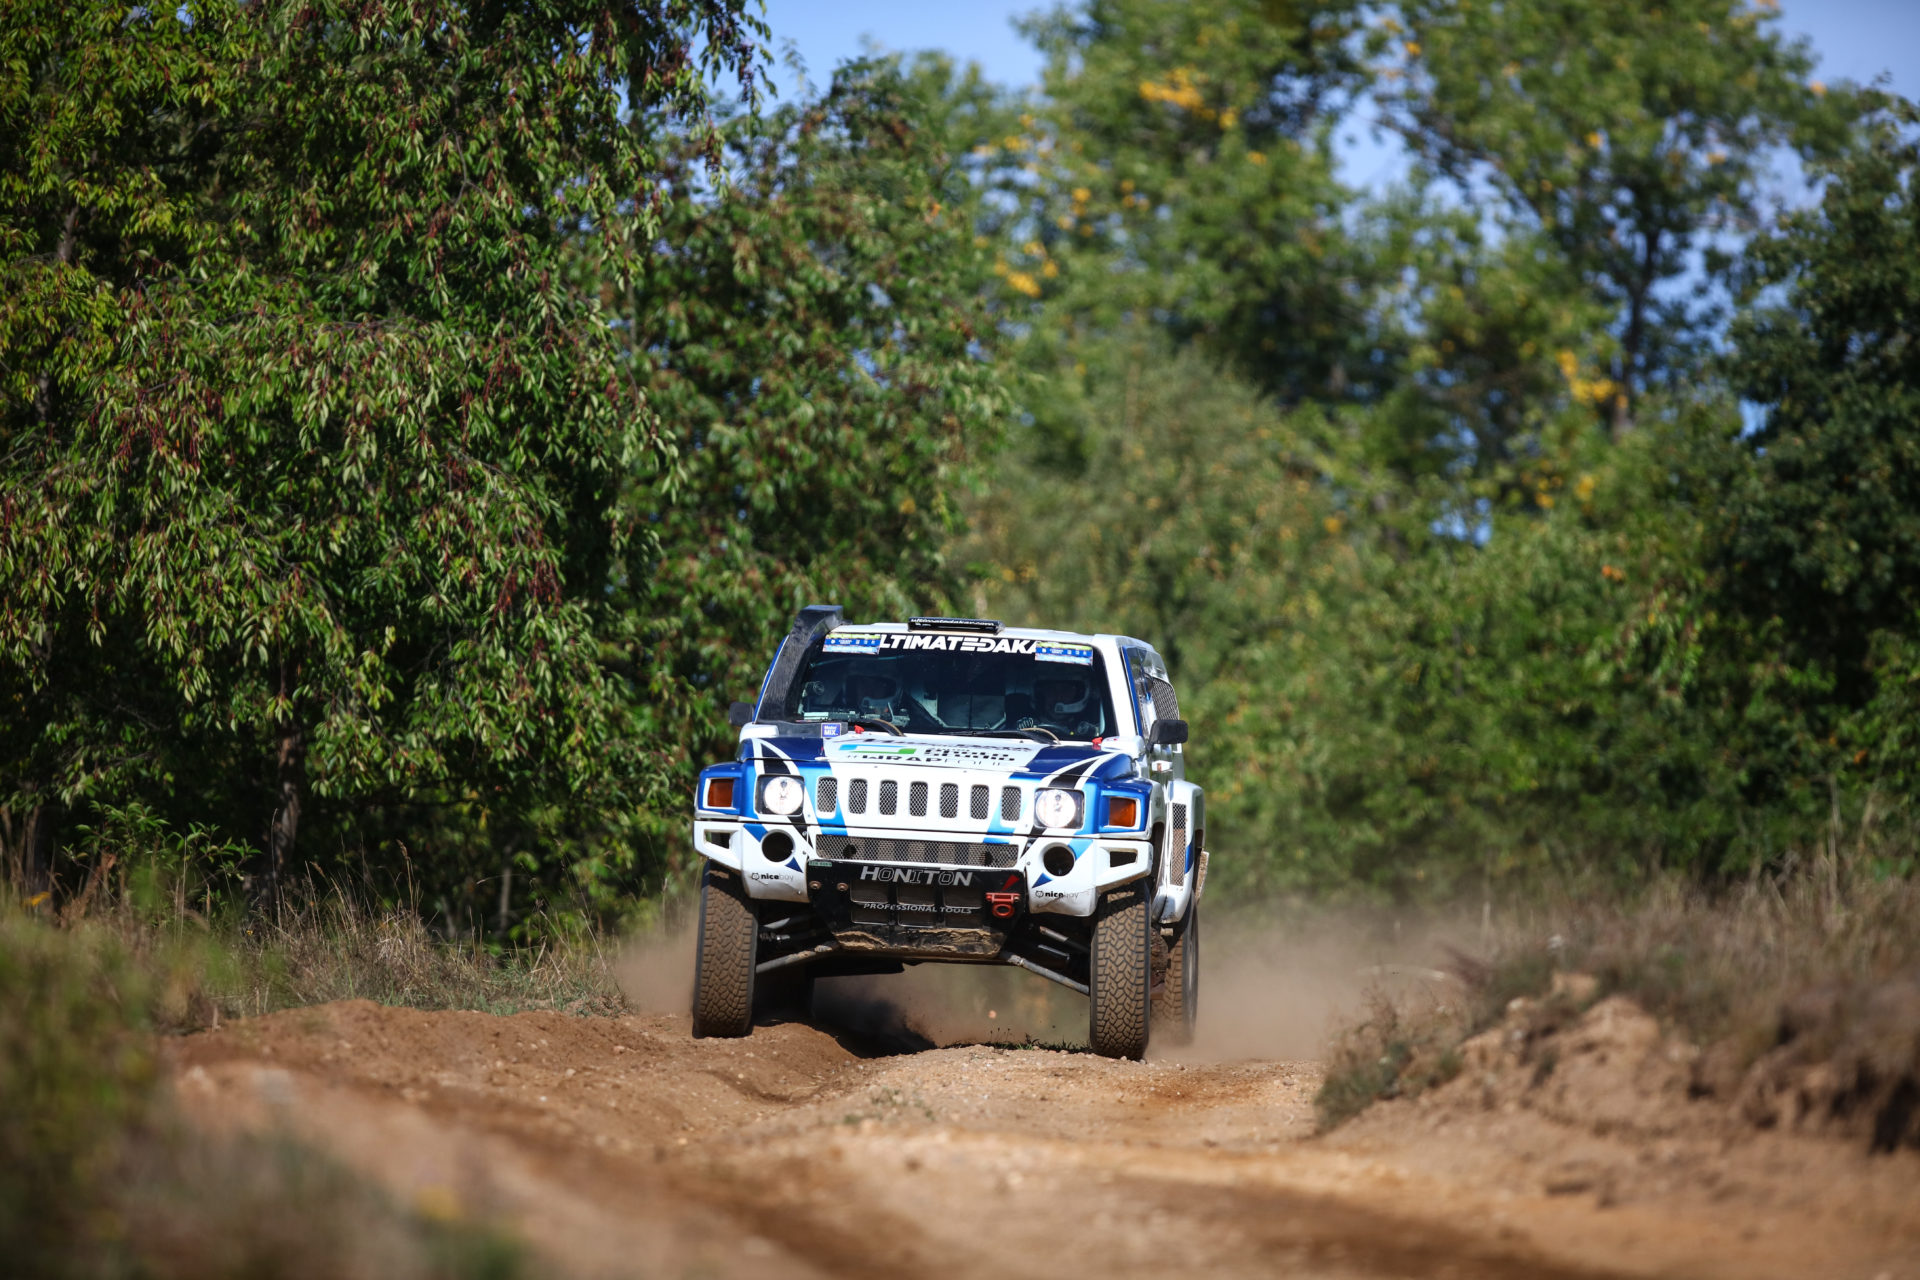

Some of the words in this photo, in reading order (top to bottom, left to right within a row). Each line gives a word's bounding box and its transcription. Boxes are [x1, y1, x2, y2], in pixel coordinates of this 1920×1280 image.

[880, 633, 1036, 654] LTIMATEDAKA
[860, 865, 974, 887] HONITON
[863, 903, 938, 913] PROFESSIONAL
[940, 906, 972, 914] TOOLS
